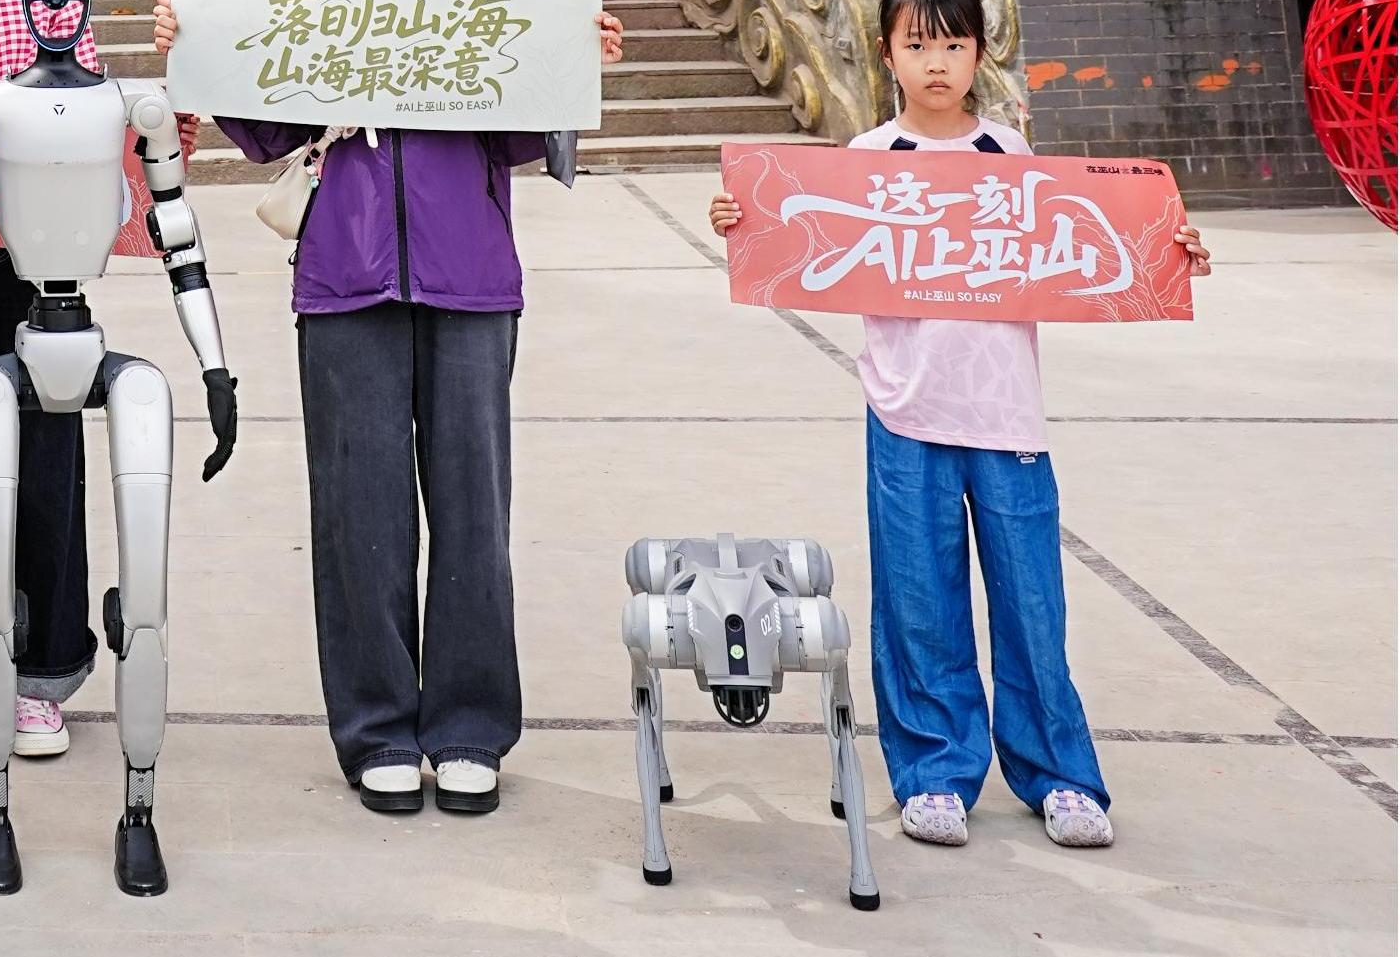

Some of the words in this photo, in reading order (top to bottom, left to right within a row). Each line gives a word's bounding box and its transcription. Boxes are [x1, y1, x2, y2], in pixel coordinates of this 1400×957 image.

[256, 41, 502, 105] 山海最深意
[396, 101, 446, 112] #AI上巫山
[448, 101, 464, 111] SO
[466, 99, 495, 110] EASY
[780, 171, 1058, 233] 这一刻
[801, 200, 1134, 295] AI上巫山
[903, 289, 955, 303] #AI上巫山
[957, 291, 973, 302] SO
[975, 292, 1002, 304] EASY
[760, 614, 773, 636] 02
